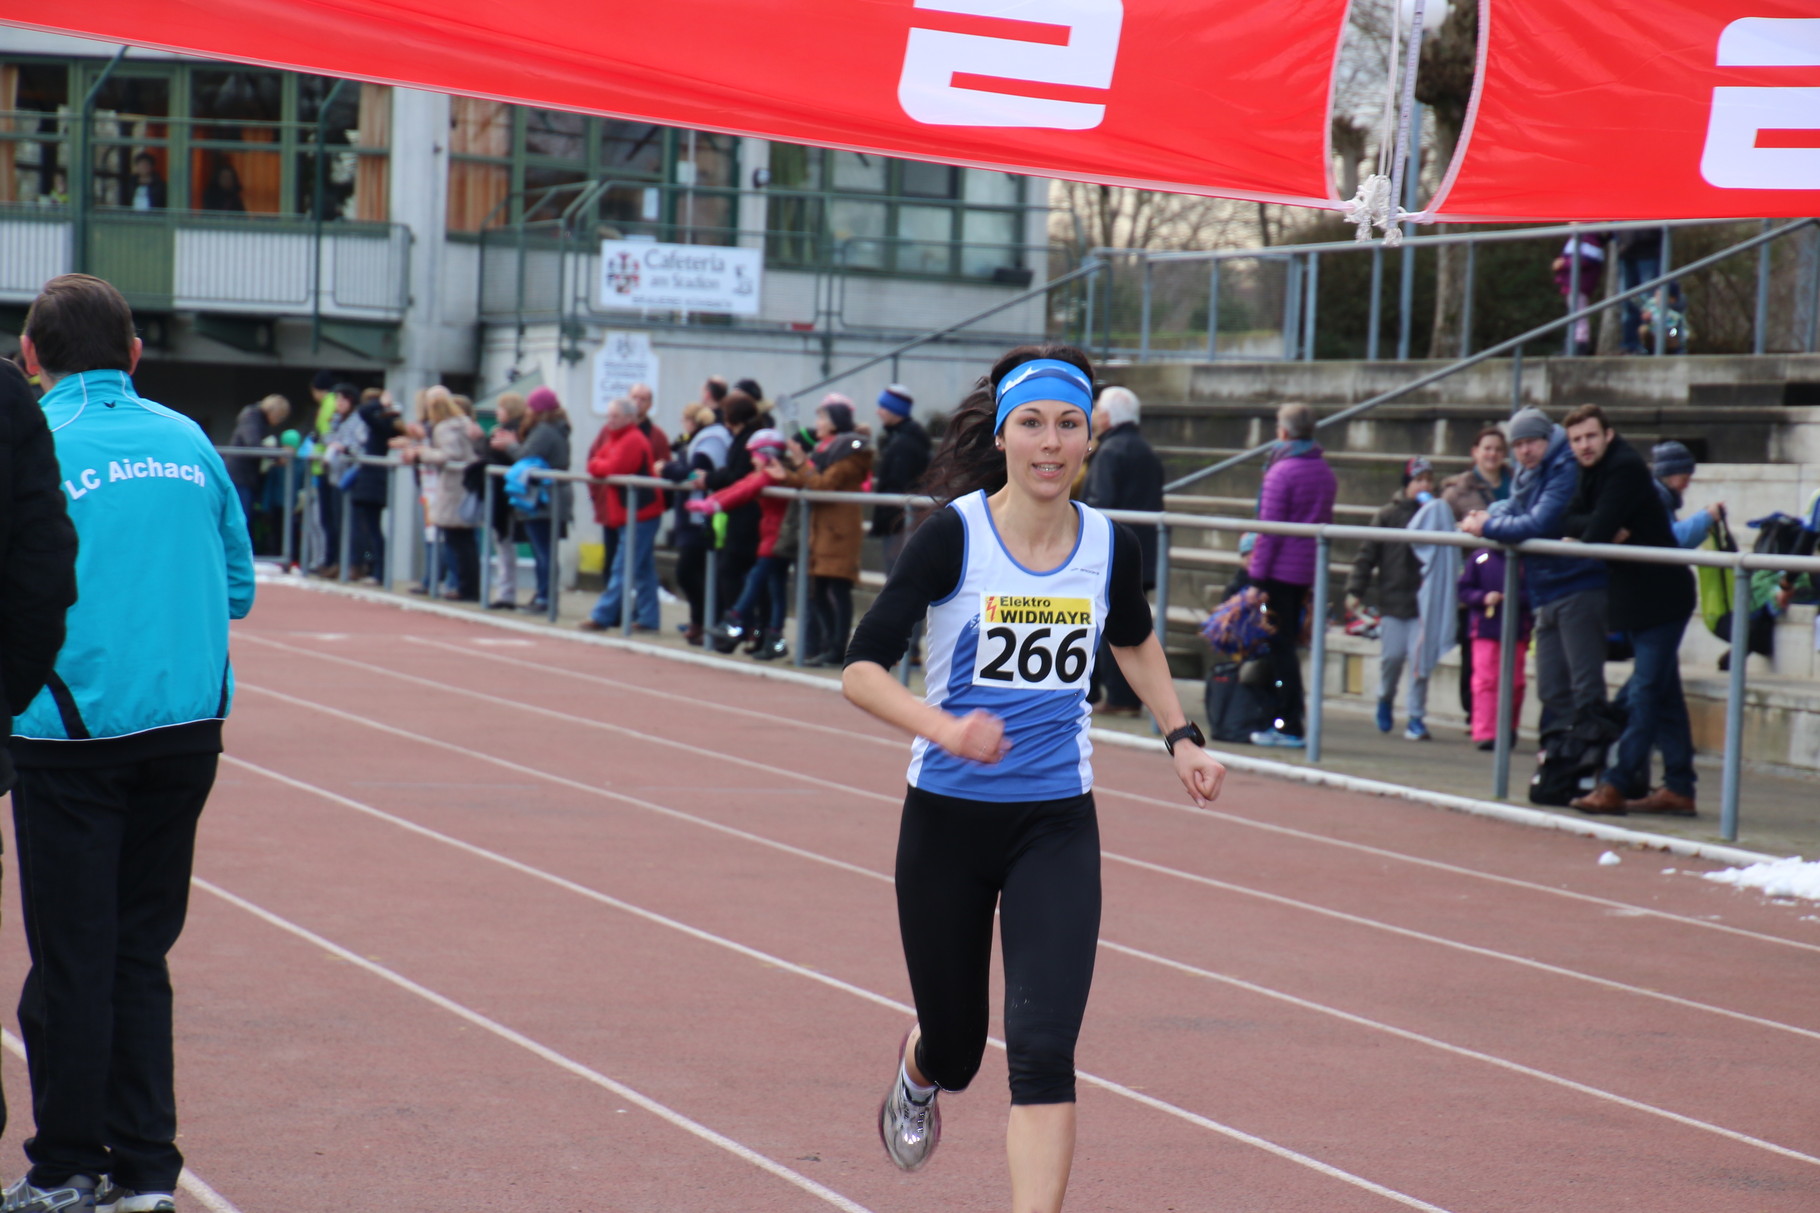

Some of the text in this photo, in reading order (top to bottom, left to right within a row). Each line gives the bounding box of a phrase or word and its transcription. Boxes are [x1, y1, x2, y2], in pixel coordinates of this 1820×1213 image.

[643, 248, 726, 272] Cafeteria
[64, 457, 206, 500] LC Aichach
[1000, 596, 1051, 607] Elektro
[1000, 610, 1092, 625] WIDMAYR
[979, 626, 1088, 684] 266
